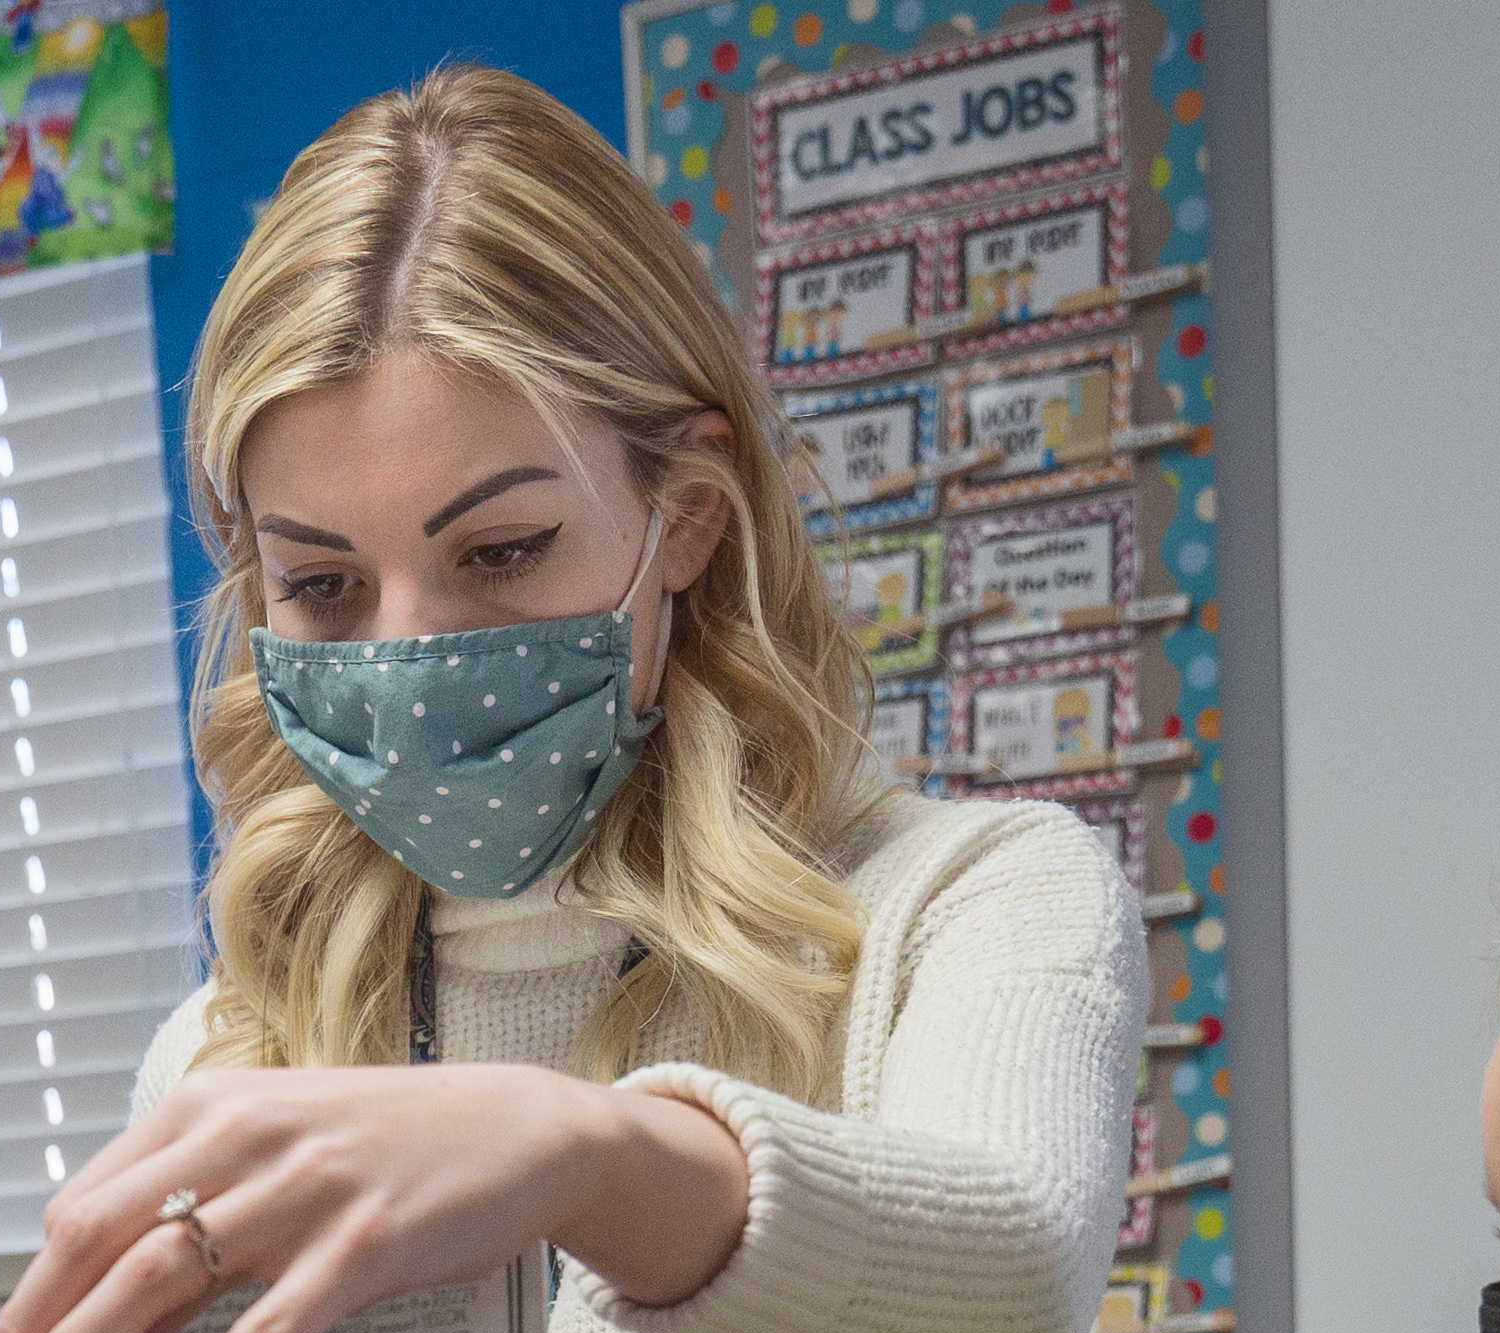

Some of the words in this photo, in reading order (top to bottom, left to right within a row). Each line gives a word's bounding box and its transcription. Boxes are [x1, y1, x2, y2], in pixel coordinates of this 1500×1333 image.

[789, 104, 934, 183] CLASS
[950, 70, 1076, 147] JOBS
[993, 537, 1088, 567] Question
[1014, 575, 1050, 592] the
[1053, 567, 1095, 591] Day
